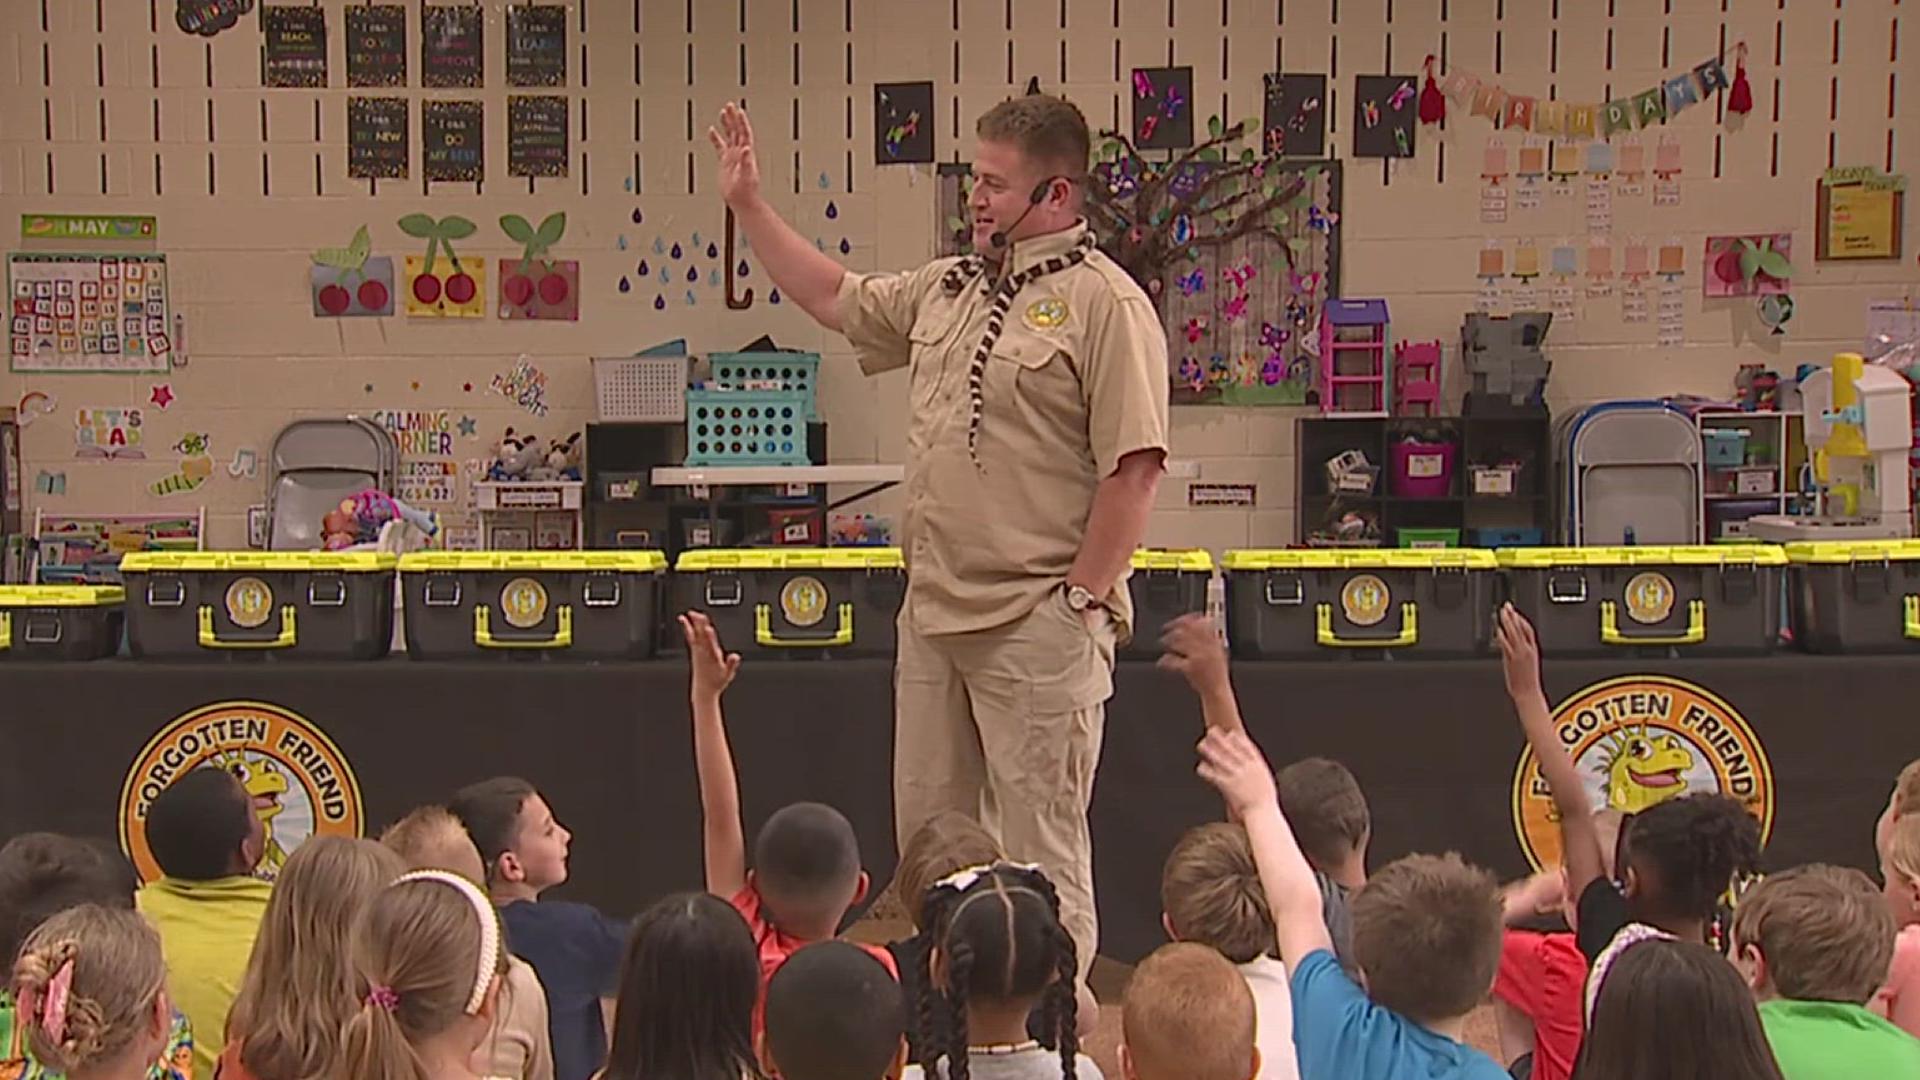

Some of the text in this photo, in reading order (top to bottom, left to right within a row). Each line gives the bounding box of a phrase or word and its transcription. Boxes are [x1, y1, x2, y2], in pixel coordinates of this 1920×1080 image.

[444, 133, 465, 146] DO
[430, 149, 447, 160] MY
[68, 219, 110, 235] MAY
[79, 409, 142, 428] LET'S
[79, 427, 141, 446] READ
[1532, 693, 1753, 798] FGOTTEN FRIEND
[136, 718, 345, 820] FORGOTTEN FRIEND
